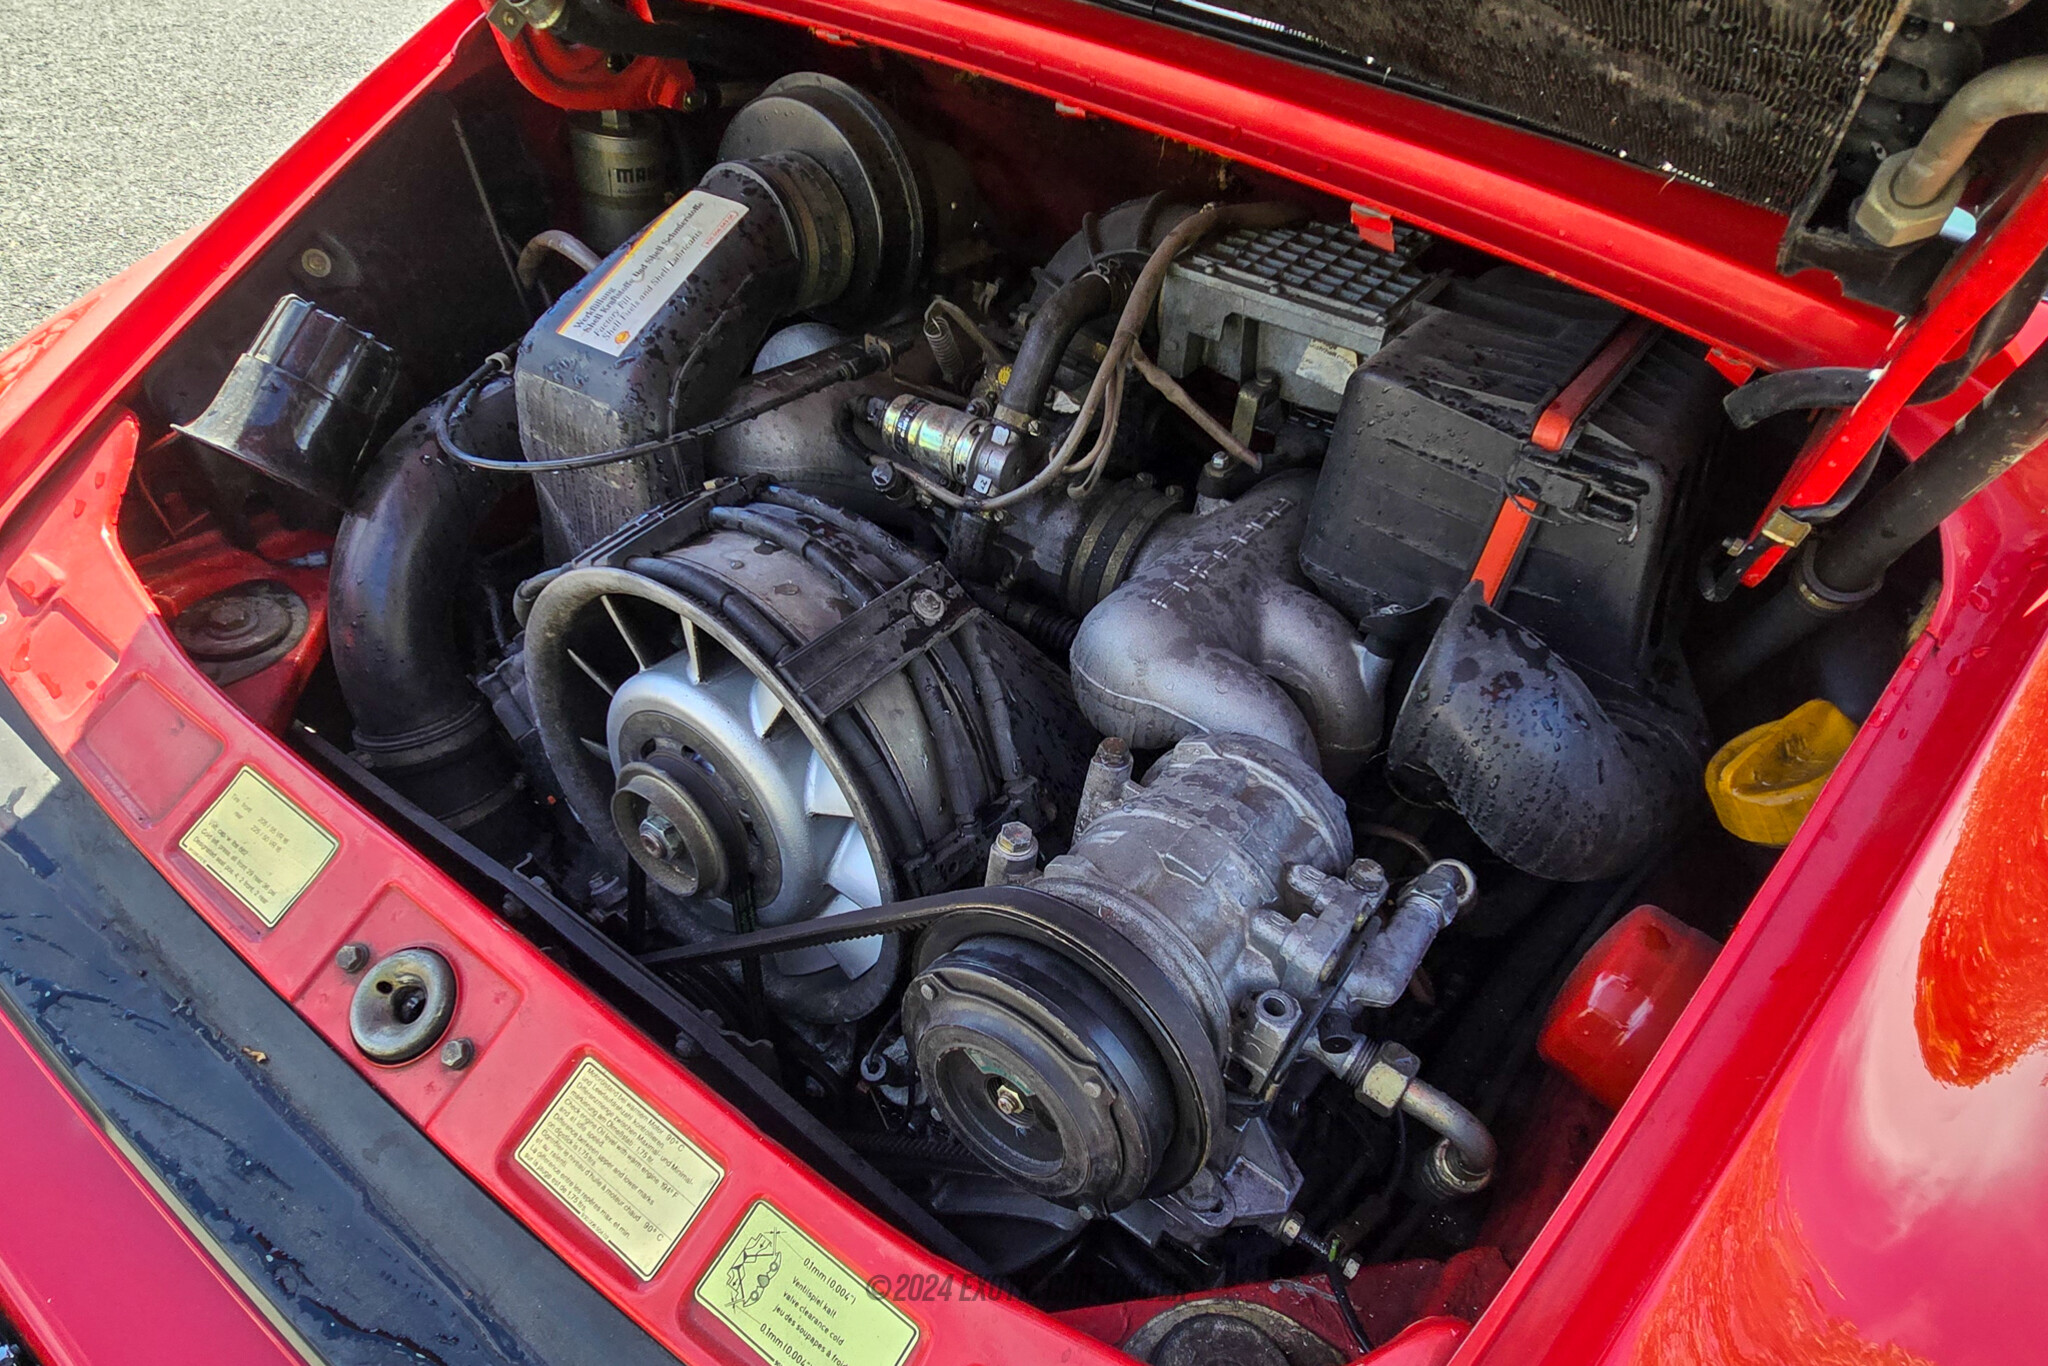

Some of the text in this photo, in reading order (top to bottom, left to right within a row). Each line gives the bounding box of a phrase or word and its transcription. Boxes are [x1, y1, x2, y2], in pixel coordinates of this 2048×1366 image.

[580, 312, 604, 333] Shell
[643, 245, 665, 264] Shell
[659, 201, 706, 246] Schmierstoffe
[598, 229, 705, 340] Shell Fuels and Shell Lubricants
[571, 286, 616, 329] Werkfüllung
[590, 295, 632, 336] Factory Fill
[558, 1104, 571, 1117] and
[569, 1114, 577, 1123] at
[580, 1074, 593, 1087] und
[631, 1118, 665, 1149] kontrollieren
[534, 1135, 543, 1145] et
[547, 1120, 556, 1129] on
[553, 1125, 574, 1146] dipstick
[563, 1097, 581, 1114] Check
[577, 1111, 598, 1131] engine
[603, 1132, 618, 1147] level
[615, 1142, 629, 1156] with
[626, 1152, 643, 1169] warm
[639, 1164, 661, 1186] engine
[647, 1118, 664, 1135] Motor
[676, 1143, 685, 1153] C
[523, 1151, 534, 1162] sur
[532, 1158, 539, 1167] la
[535, 1163, 553, 1181] jauge
[552, 1112, 655, 1206] Difference between upper and lower marks
[659, 1153, 672, 1167] und
[529, 1143, 538, 1154] La
[559, 1171, 575, 1187] entre
[572, 1183, 582, 1194] les
[612, 1220, 620, 1229] et
[550, 1175, 561, 1187] est
[558, 1183, 568, 1194] de
[562, 1148, 570, 1157] le
[567, 1153, 586, 1172] niveau
[604, 1187, 625, 1207] moteur
[622, 1203, 641, 1222] chaud
[655, 1232, 664, 1242] C
[781, 1289, 845, 1346] valve clearance cold
[790, 1275, 838, 1319] Ventilspiel kalt
[771, 1303, 786, 1319] jeu
[783, 1312, 798, 1328] des
[793, 1323, 827, 1355] soupapes
[824, 1347, 833, 1358] à
